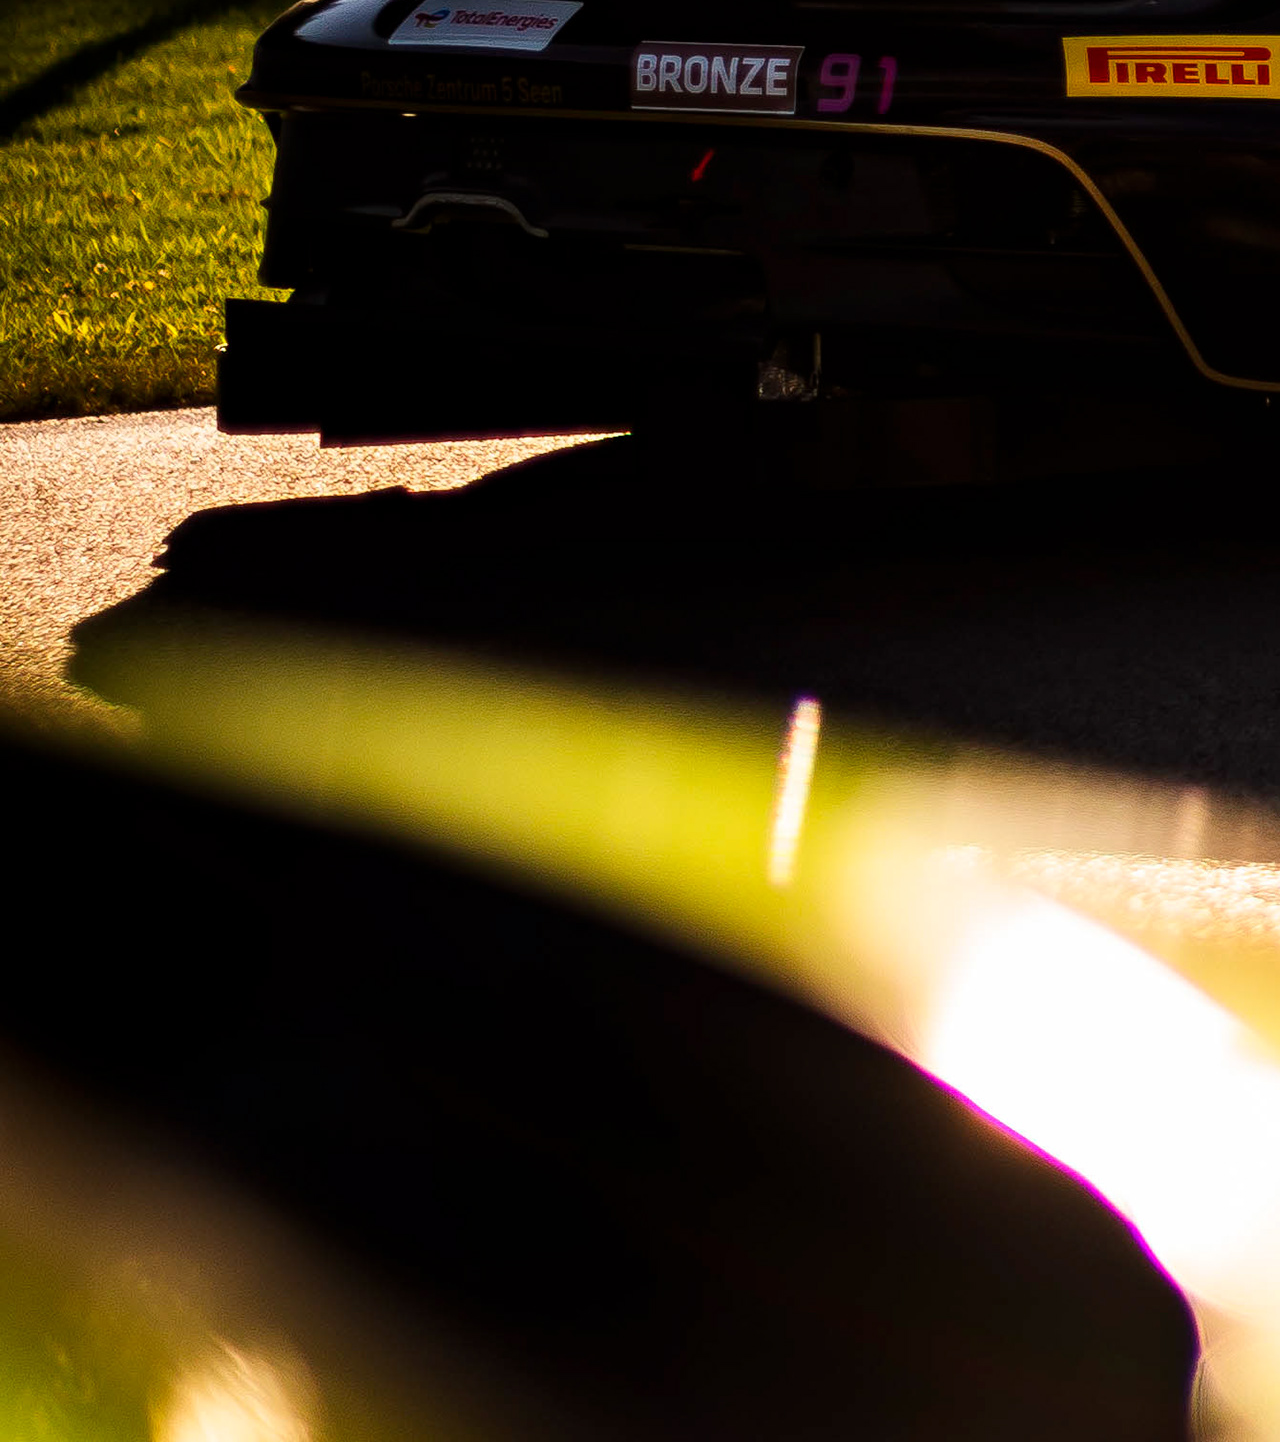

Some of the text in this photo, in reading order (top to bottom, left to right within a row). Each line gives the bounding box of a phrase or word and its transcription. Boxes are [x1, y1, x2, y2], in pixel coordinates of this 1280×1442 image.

[451, 10, 559, 31] TotalEnergies
[636, 53, 791, 97] BRONZE
[816, 53, 898, 115] 91
[1087, 47, 1271, 86] PIRELLI
[361, 71, 564, 104] Porsche Zentrum 5 Seen
